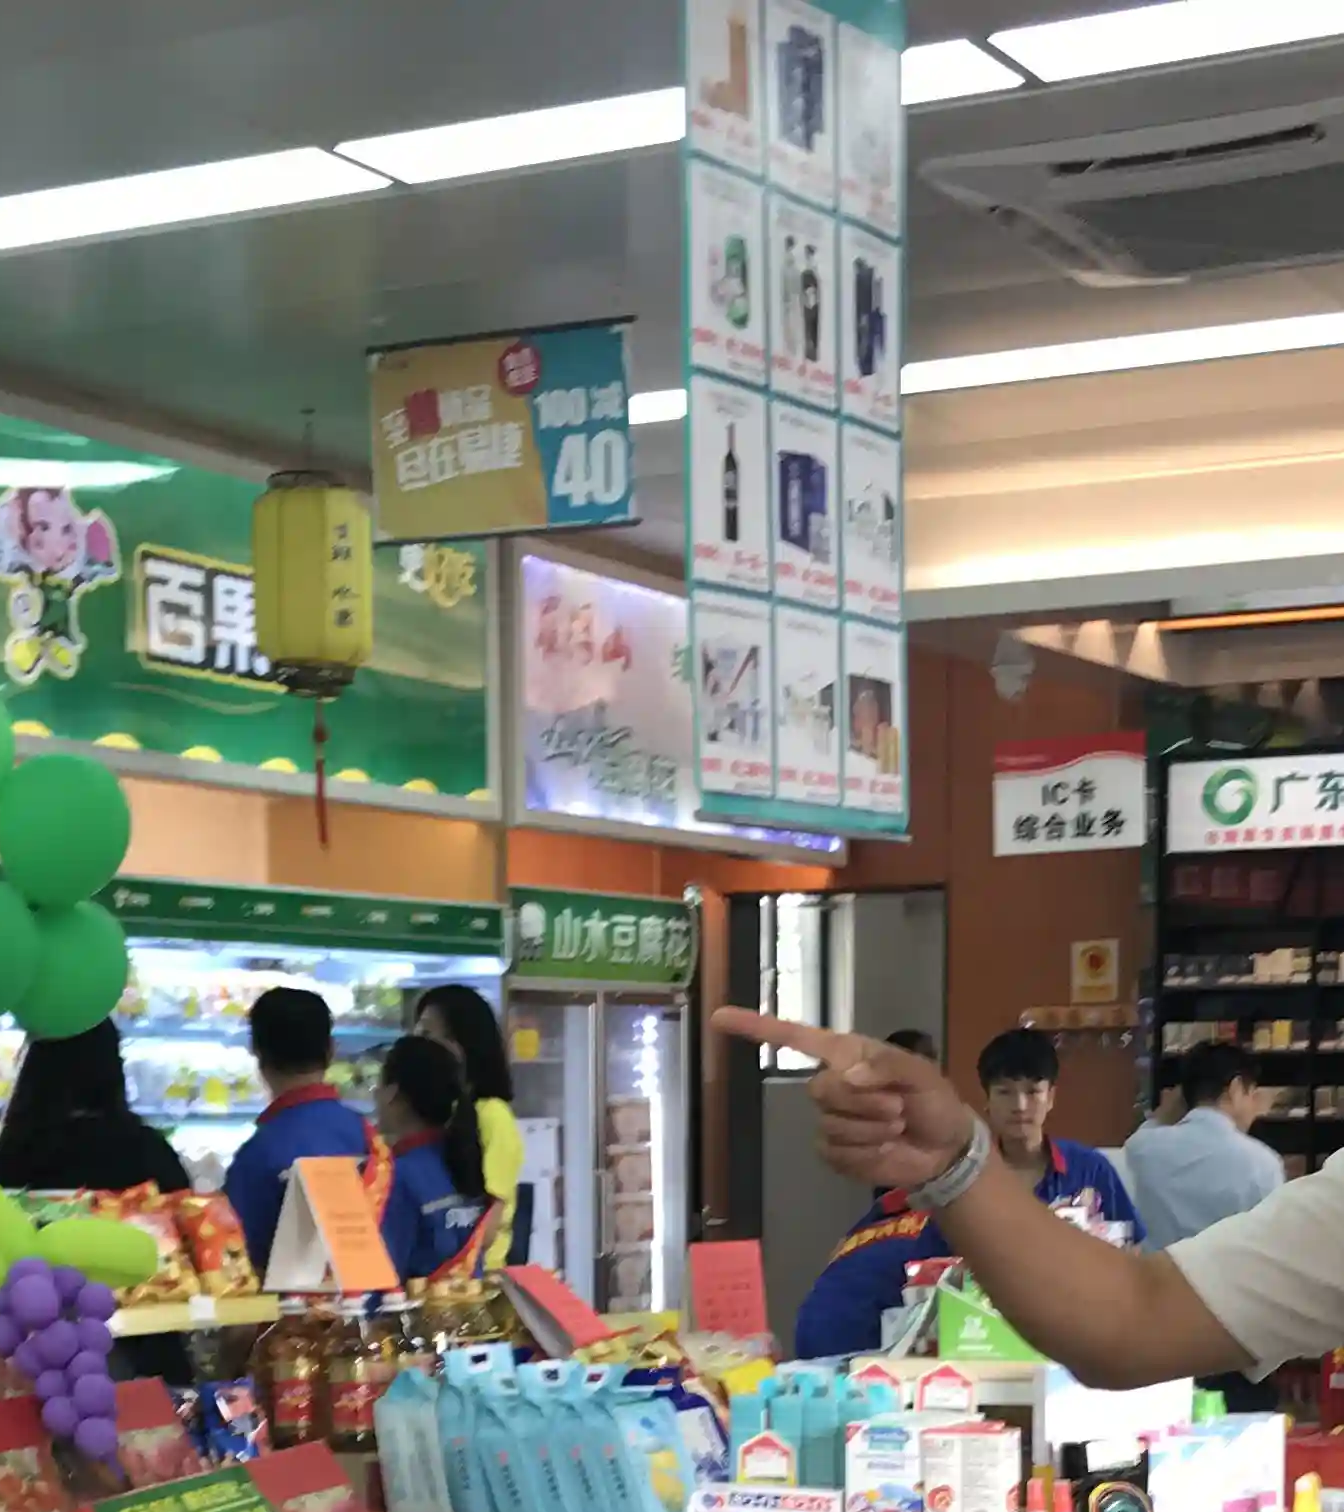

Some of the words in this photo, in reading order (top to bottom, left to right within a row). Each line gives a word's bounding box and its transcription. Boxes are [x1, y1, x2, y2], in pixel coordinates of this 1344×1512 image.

[552, 428, 628, 508] 40
[1042, 776, 1097, 807] IC卡
[1012, 808, 1128, 842] 综合业务
[551, 906, 692, 969] 山水豆腐花
